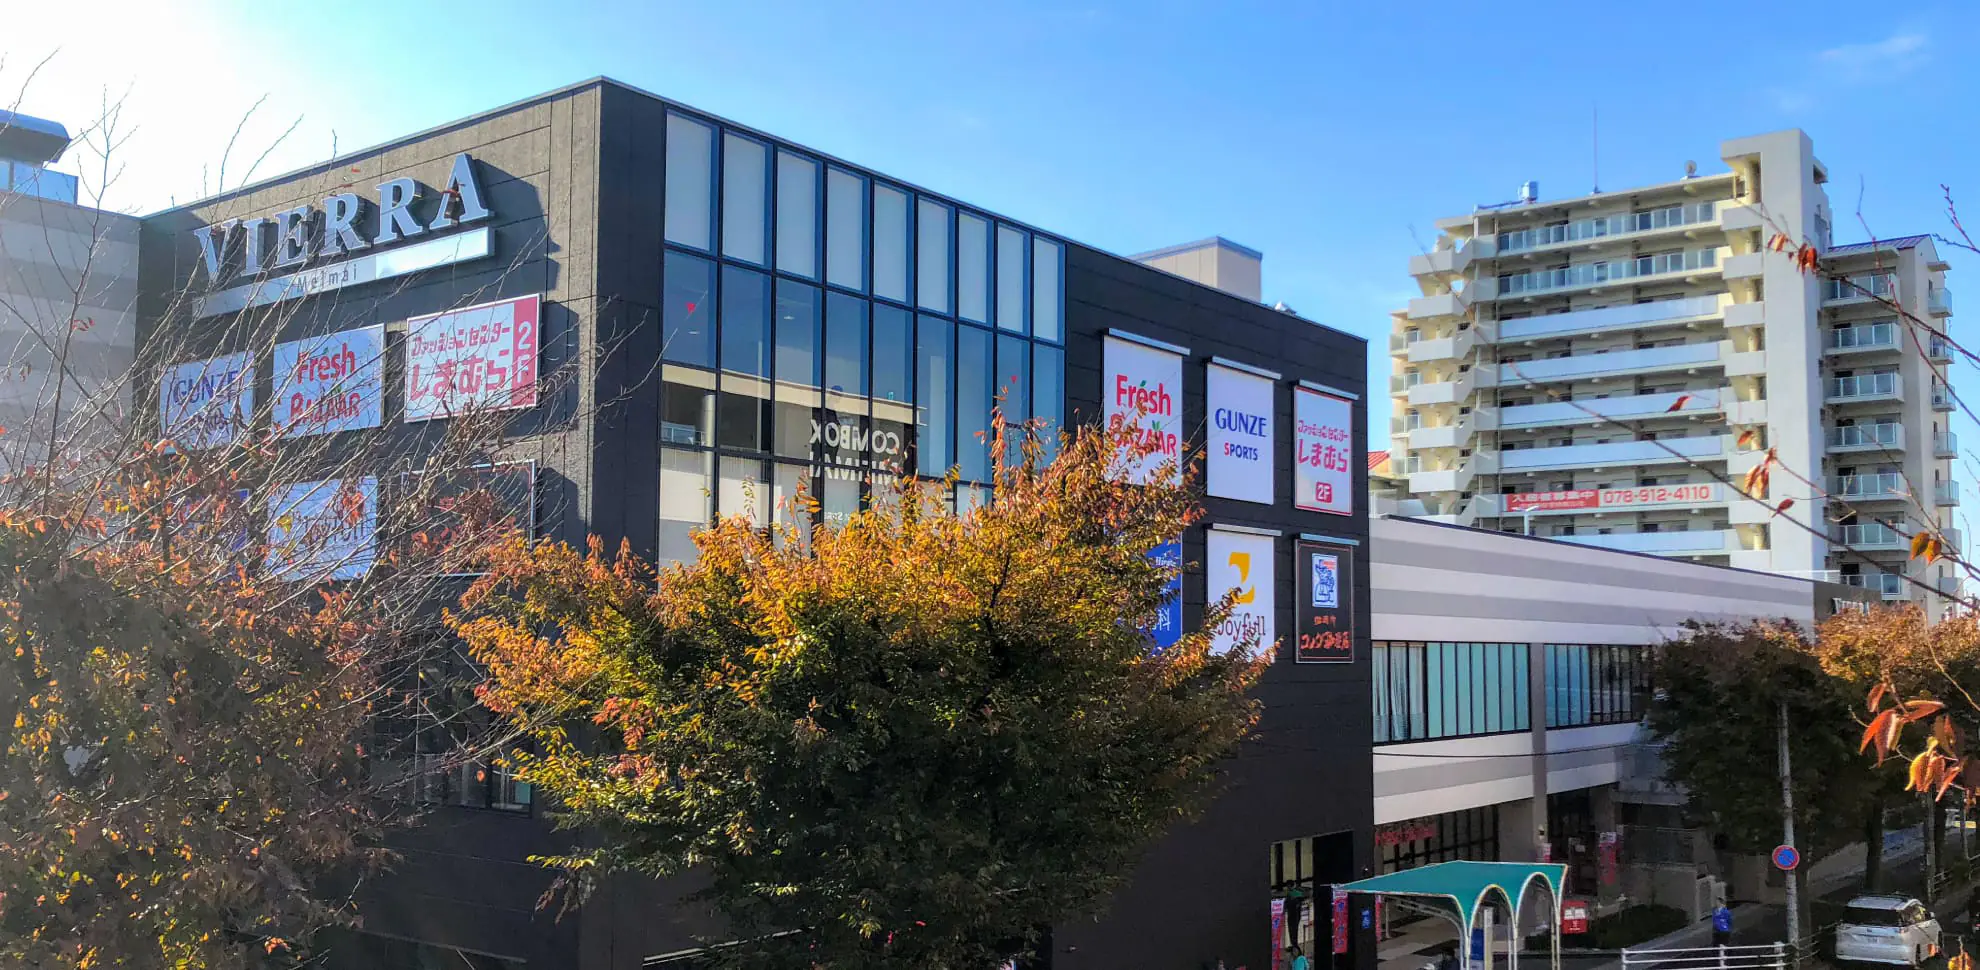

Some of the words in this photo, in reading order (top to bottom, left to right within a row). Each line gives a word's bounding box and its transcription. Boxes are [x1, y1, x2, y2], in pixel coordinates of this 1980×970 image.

[194, 153, 494, 282] VIERRA
[410, 349, 511, 401] しまむら
[1215, 408, 1267, 437] GUNZE
[1224, 442, 1258, 461] SPORTS
[1298, 439, 1349, 472] しまむら
[1318, 484, 1331, 500] 2F
[1603, 486, 1710, 504] 078-912-4110
